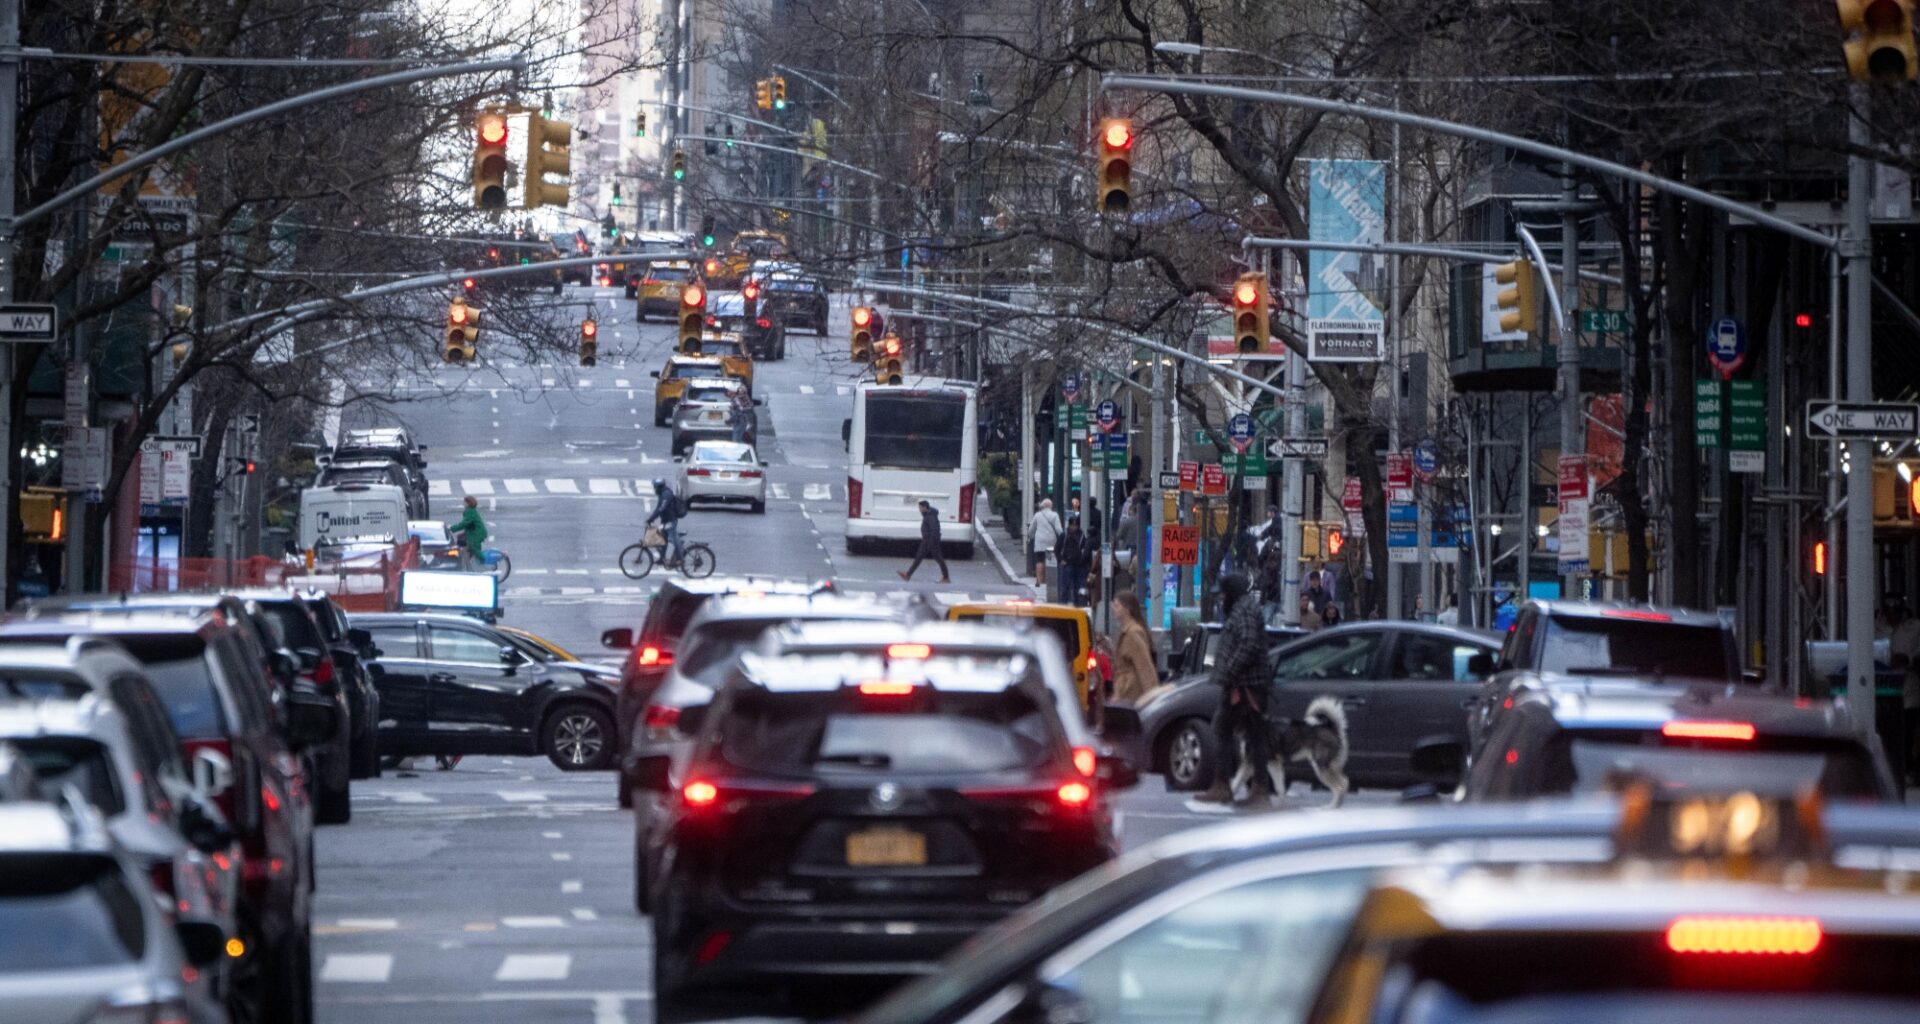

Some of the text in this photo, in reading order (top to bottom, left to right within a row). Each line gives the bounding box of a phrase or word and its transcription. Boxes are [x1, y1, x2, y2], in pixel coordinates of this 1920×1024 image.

[10, 316, 46, 330] WAY
[1591, 313, 1620, 330] E 30
[1320, 339, 1374, 348] VORNADO
[1823, 413, 1908, 428] ONE WAY
[174, 443, 193, 451] WAY
[1164, 530, 1196, 543] RAISE
[1164, 547, 1196, 562] PLOW
